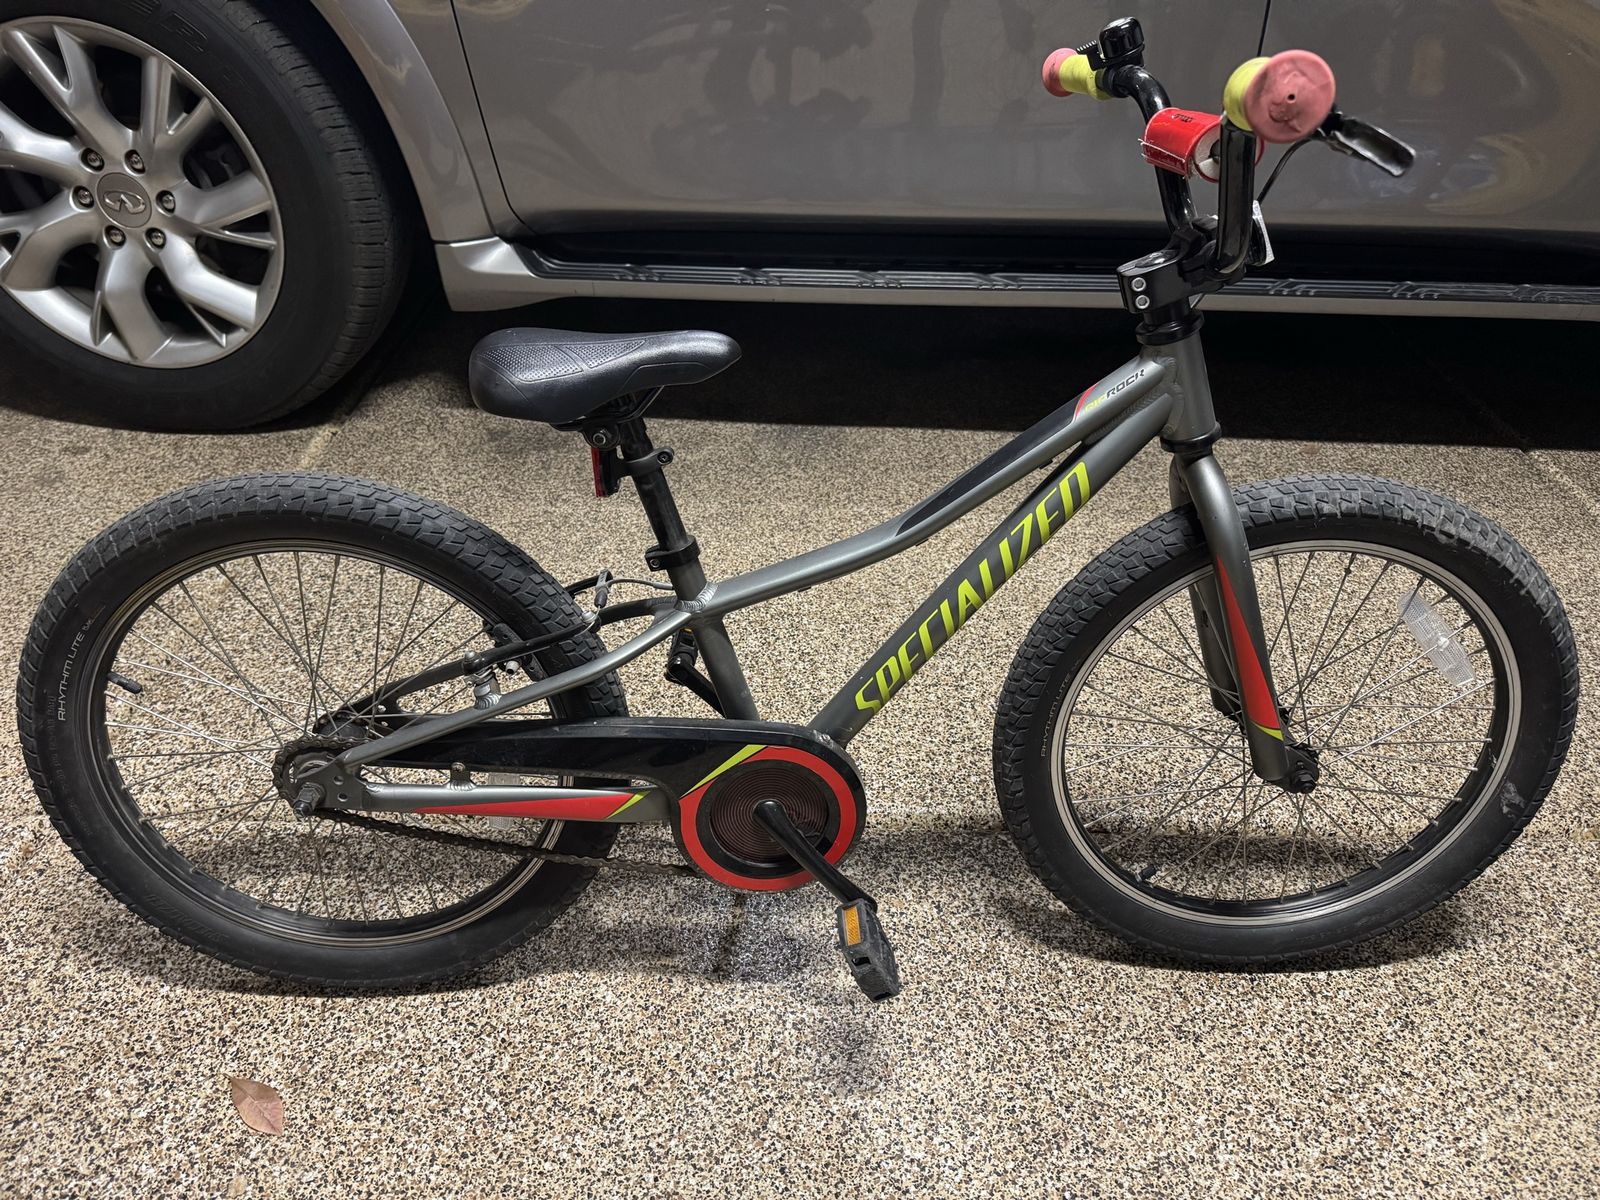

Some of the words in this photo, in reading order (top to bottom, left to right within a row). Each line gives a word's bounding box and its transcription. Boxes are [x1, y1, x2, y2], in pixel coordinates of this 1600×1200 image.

[854, 461, 1091, 714] SPECIALIZED
[57, 660, 73, 721] RHYTHM
[68, 632, 86, 661] LITE
